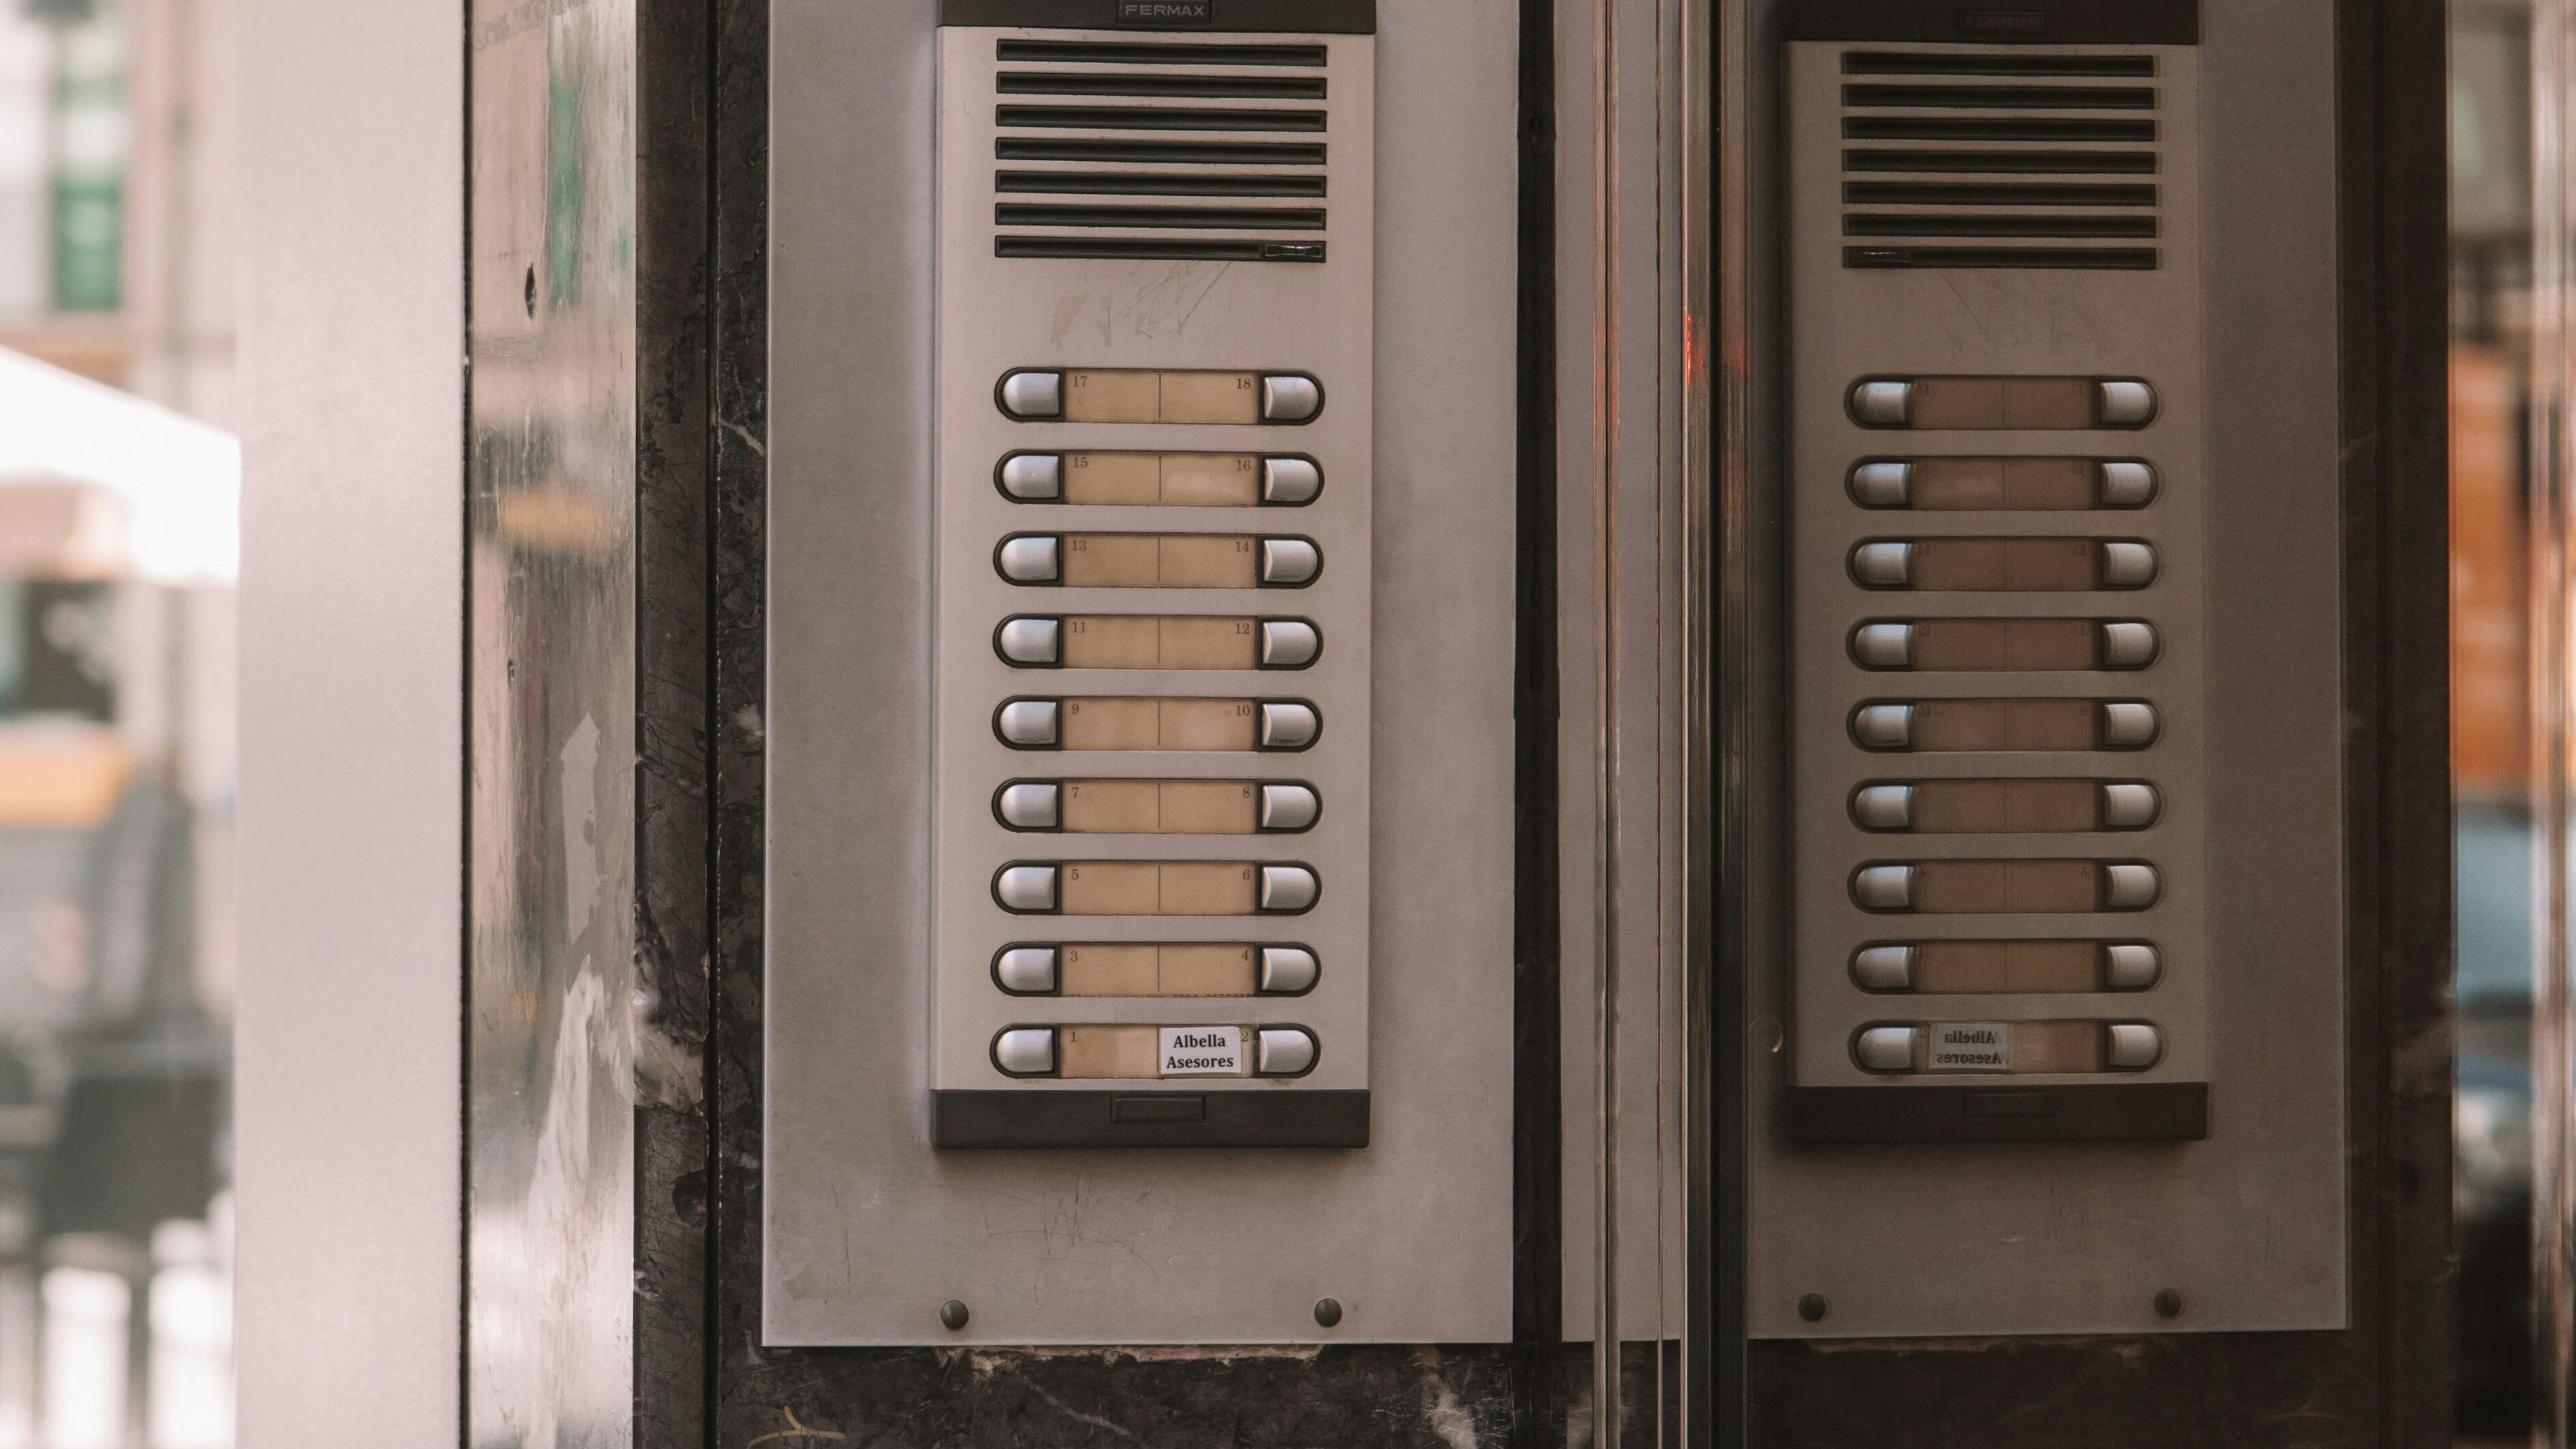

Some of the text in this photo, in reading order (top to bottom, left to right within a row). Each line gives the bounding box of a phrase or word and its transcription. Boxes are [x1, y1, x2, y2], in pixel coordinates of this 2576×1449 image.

[1125, 4, 1204, 16] FERMAX
[1072, 376, 1088, 388] 17
[1235, 377, 1251, 389] 18
[1072, 456, 1088, 469] 15
[1235, 459, 1251, 471] 16
[1071, 539, 1088, 551] 13
[1234, 541, 1251, 553] 14
[1071, 621, 1087, 633] 11
[1234, 622, 1251, 635] 12
[1070, 703, 1080, 715] 9
[1235, 704, 1251, 716] 10
[1070, 786, 1080, 799] 7
[1242, 786, 1251, 797] 8
[1070, 868, 1080, 881] 5
[1242, 868, 1251, 880] 6
[1070, 950, 1079, 962] 3
[1241, 949, 1250, 961] 4
[1070, 1031, 1077, 1043] 1
[1173, 1034, 1226, 1049] Albella
[1241, 1031, 1249, 1043] 2
[1166, 1055, 1234, 1069] Asesores
